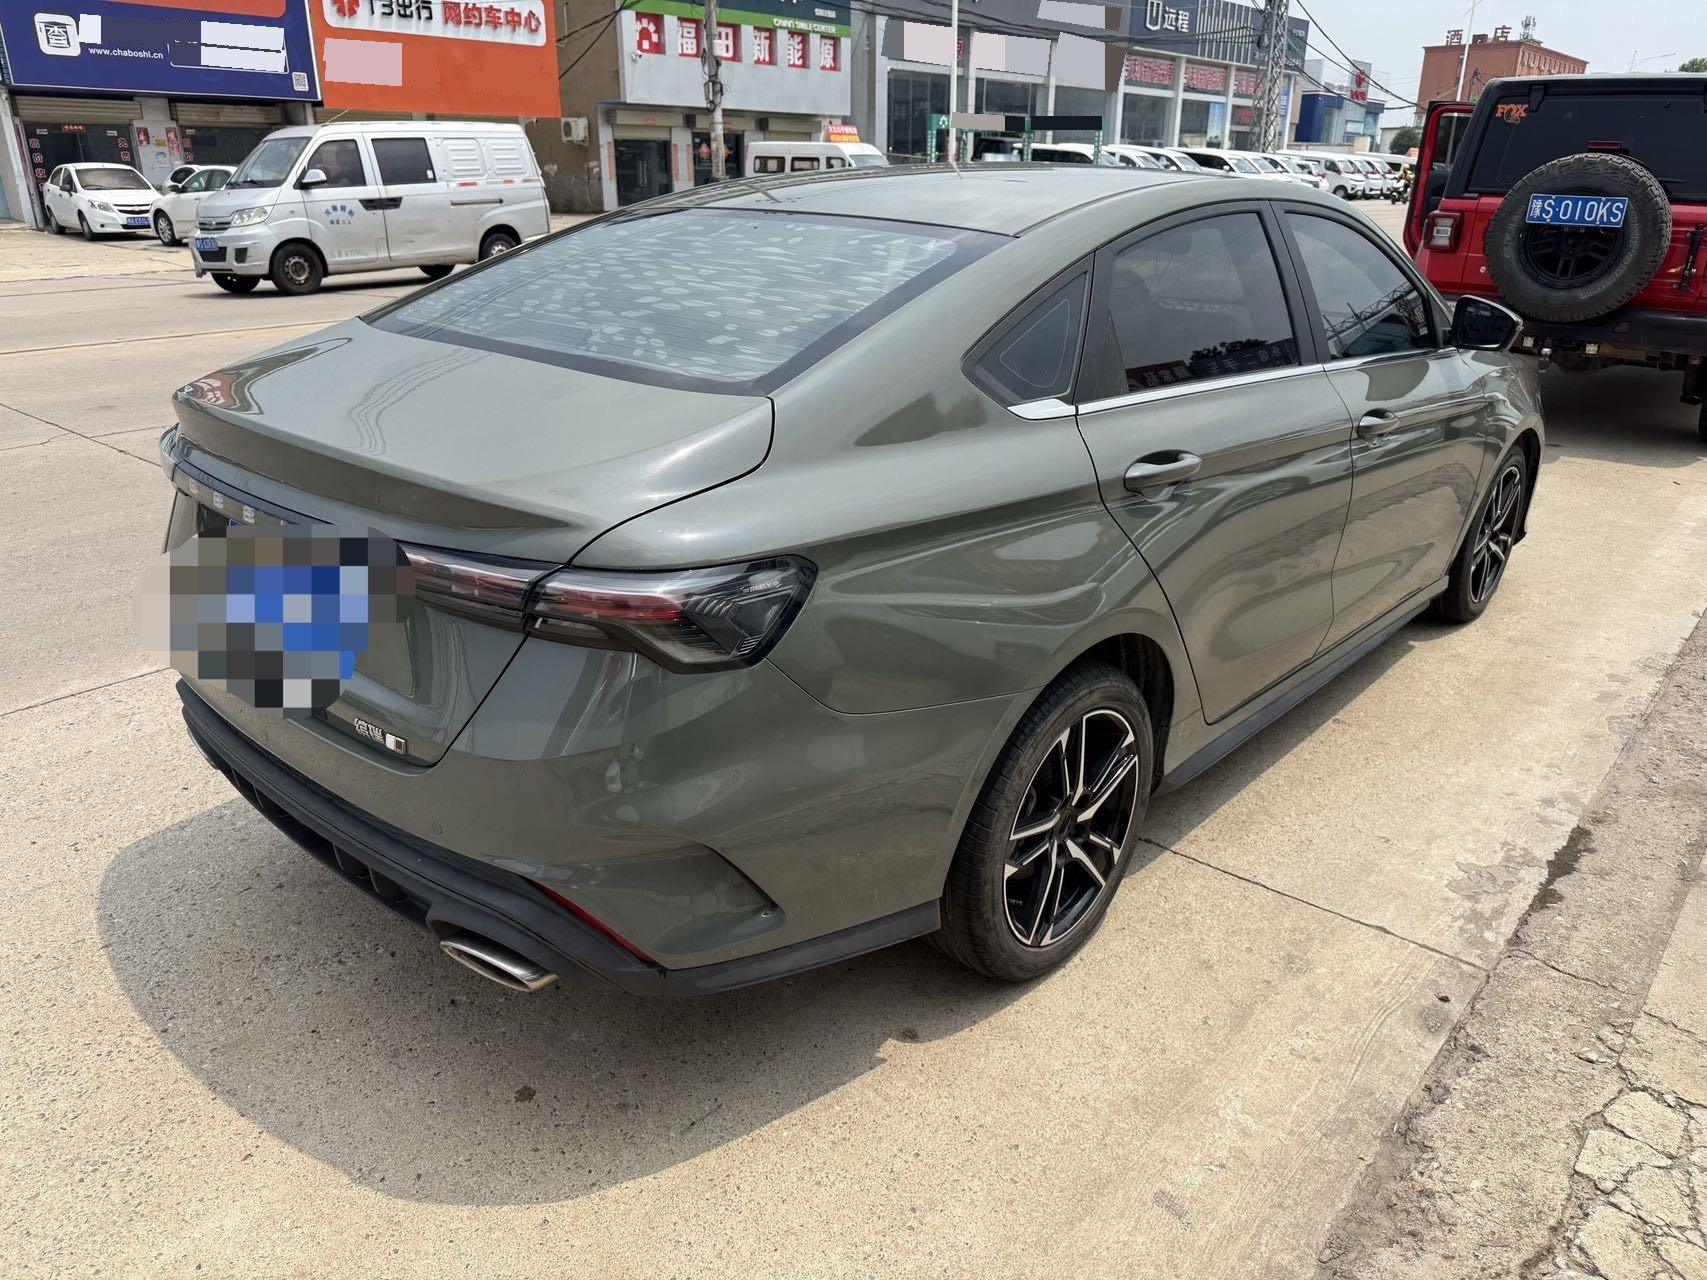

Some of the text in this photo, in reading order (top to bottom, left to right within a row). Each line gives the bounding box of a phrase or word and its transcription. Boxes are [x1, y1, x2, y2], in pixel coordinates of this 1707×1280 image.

[441, 1, 541, 33] 网约车中心
[1162, 6, 1189, 32] 远程
[88, 47, 163, 59] www.chaboshi.cn
[679, 21, 835, 68] 福田新能源
[1496, 104, 1528, 121] FOX
